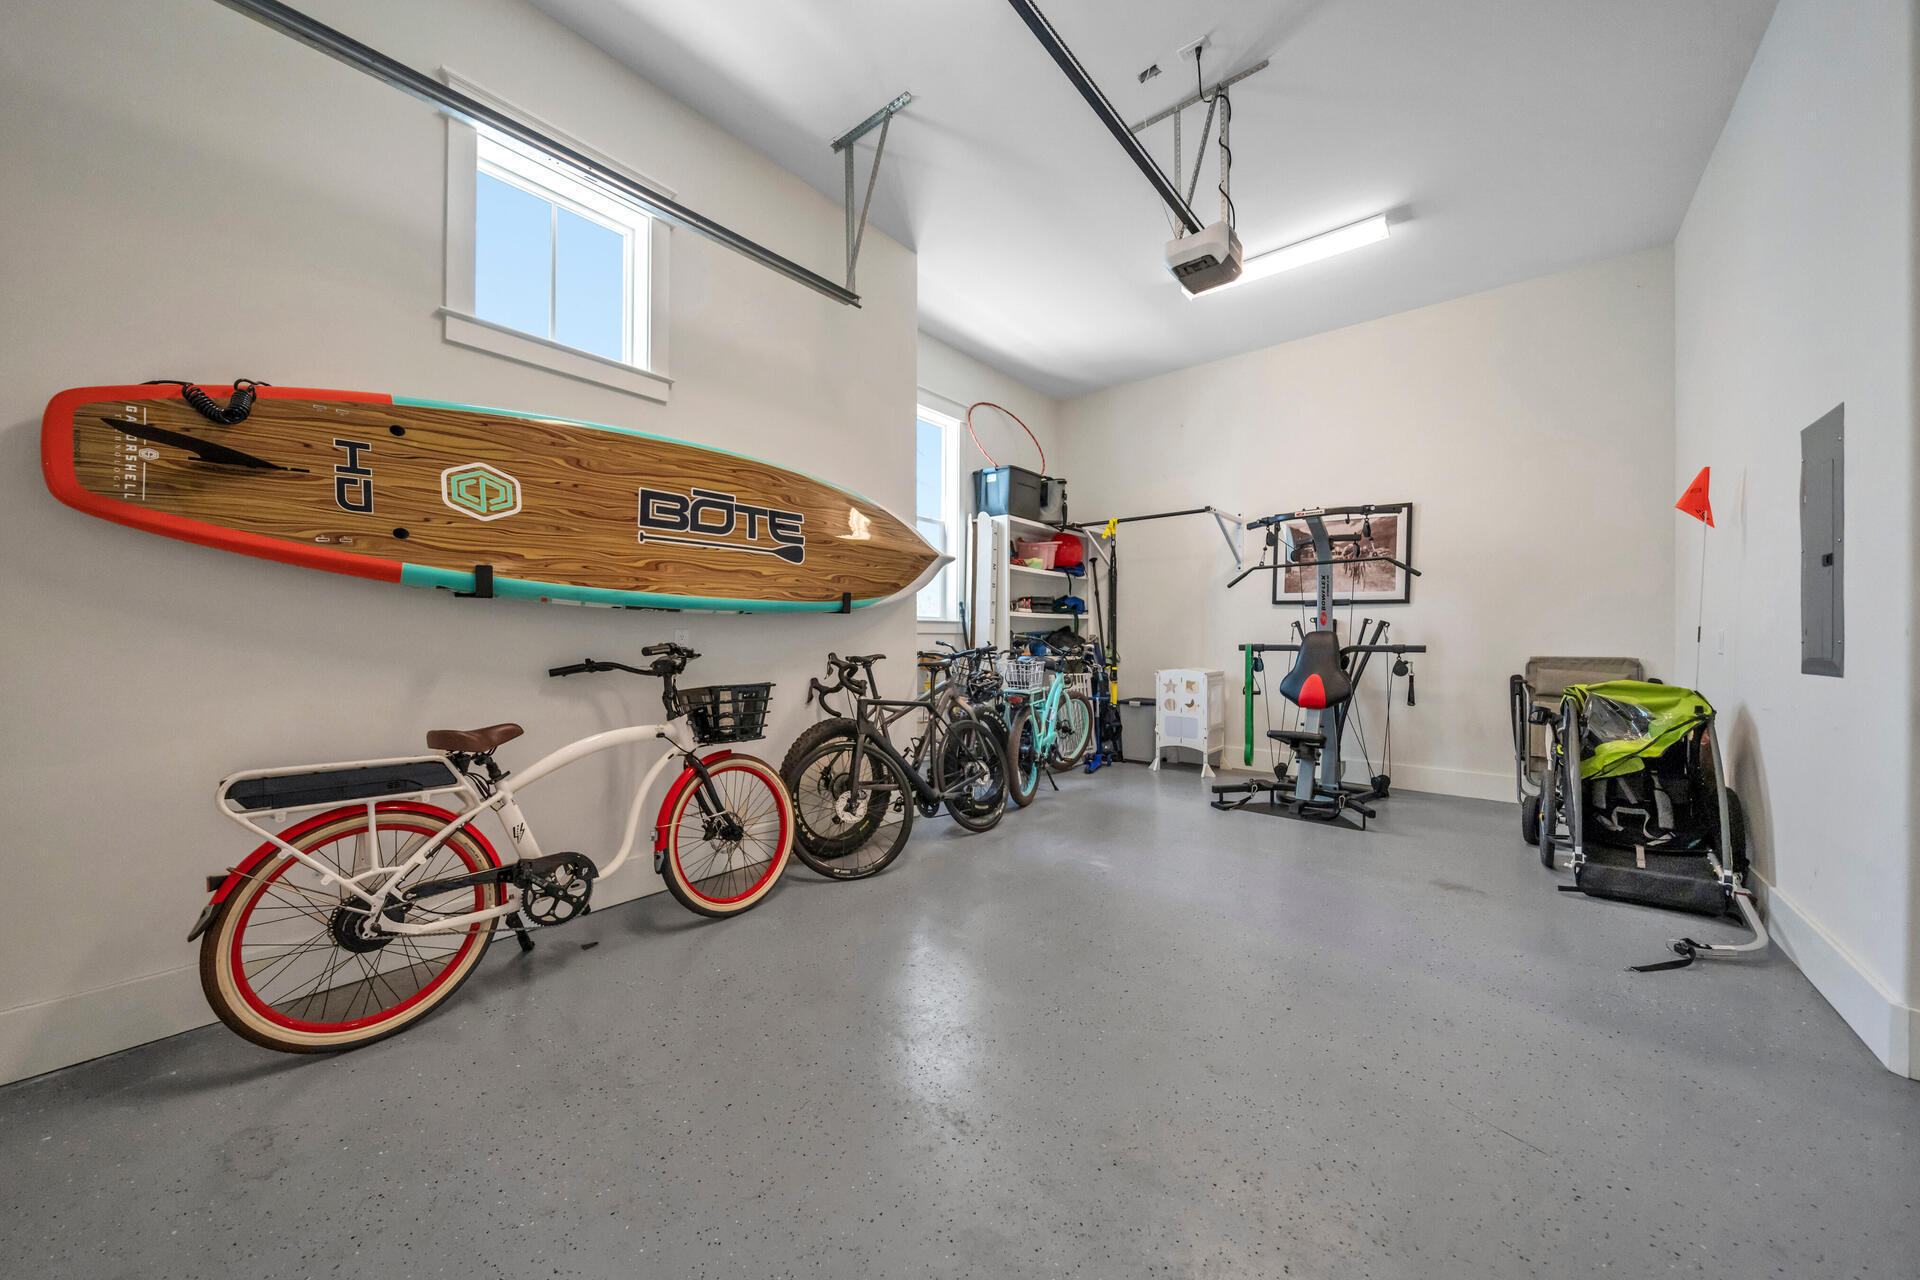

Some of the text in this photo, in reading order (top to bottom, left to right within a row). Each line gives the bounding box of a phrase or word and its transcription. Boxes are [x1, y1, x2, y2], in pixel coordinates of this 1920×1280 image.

[113, 413, 122, 488] THNOLOGY
[123, 405, 138, 498] GAORSHELL
[333, 437, 374, 514] HD
